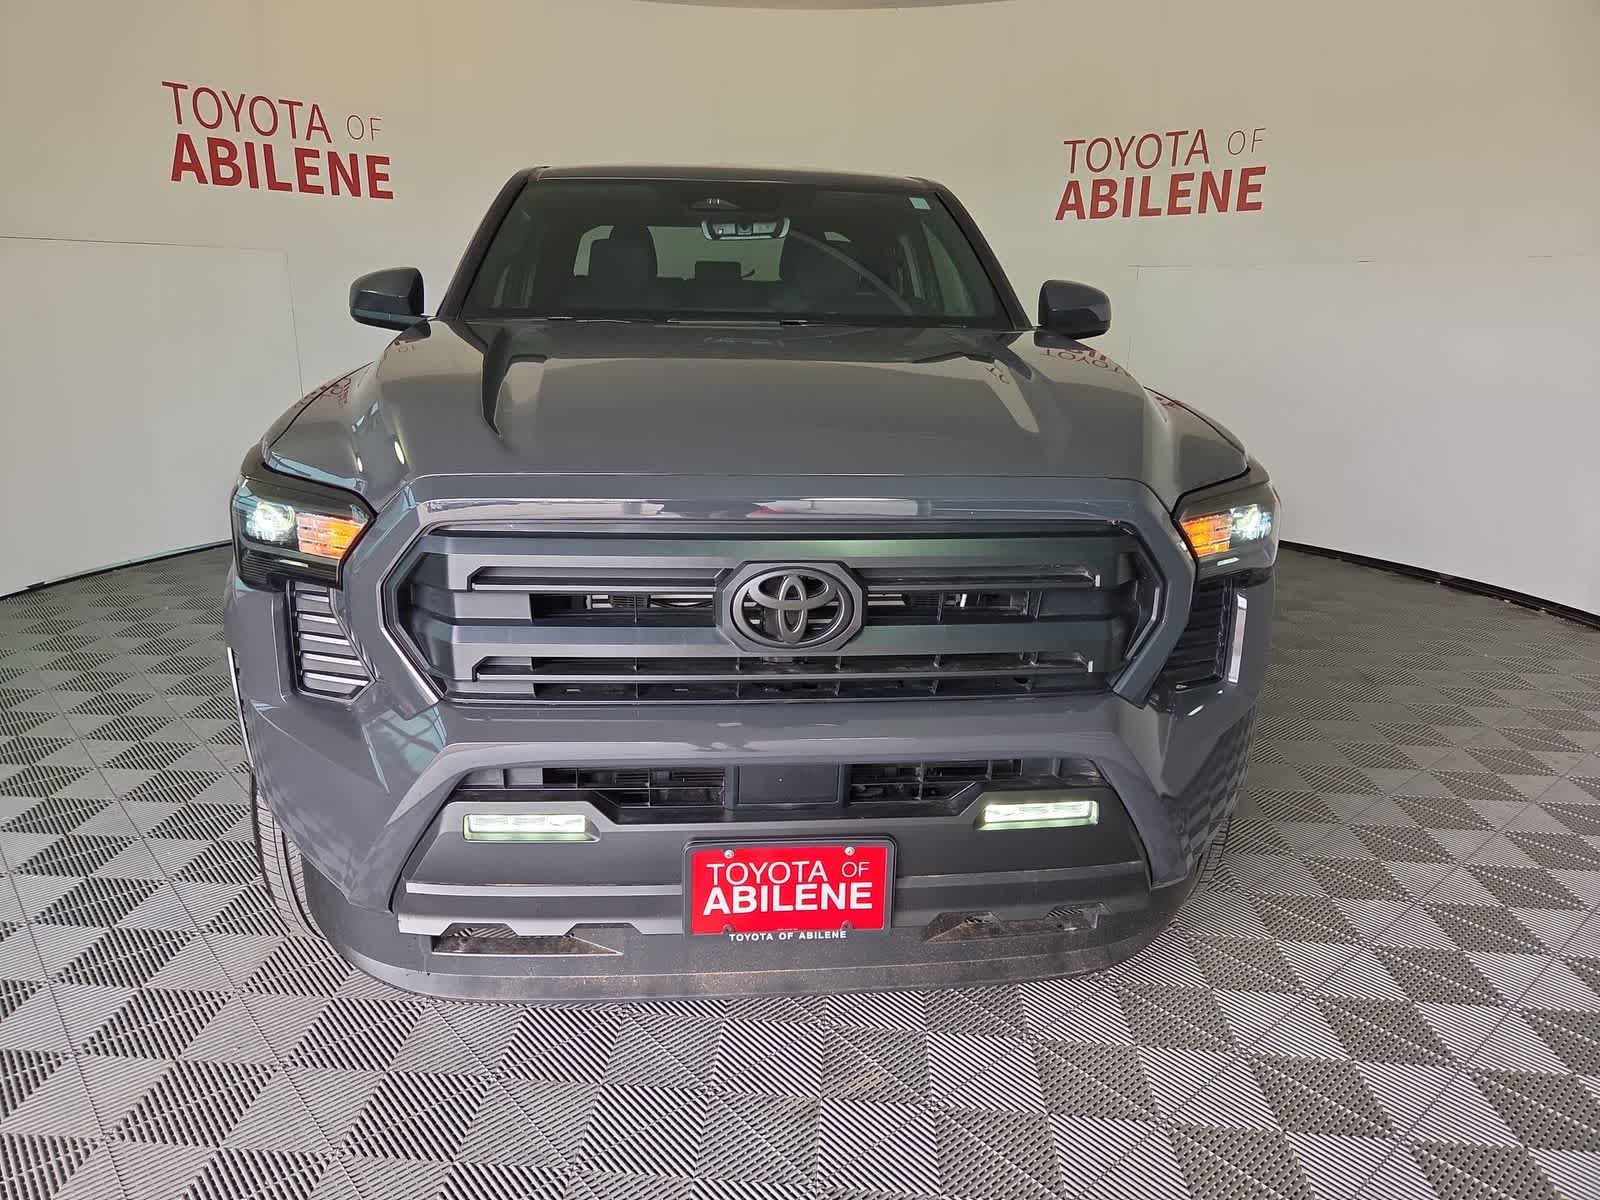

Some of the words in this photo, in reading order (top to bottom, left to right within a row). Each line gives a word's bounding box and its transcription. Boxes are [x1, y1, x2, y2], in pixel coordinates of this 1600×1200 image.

[162, 81, 333, 144] TOYOTA
[346, 114, 382, 142] OF
[170, 133, 395, 200] ABILENE
[1063, 128, 1210, 174] TOYOTA
[1227, 127, 1267, 156] OF
[1055, 166, 1267, 221] ABILENE
[706, 860, 829, 886] TOYOTA
[841, 861, 871, 878] OF
[703, 881, 874, 917] ABILENE
[728, 932, 774, 942] TOYOTA
[778, 931, 794, 941] OF
[799, 930, 848, 940] ABILENE
